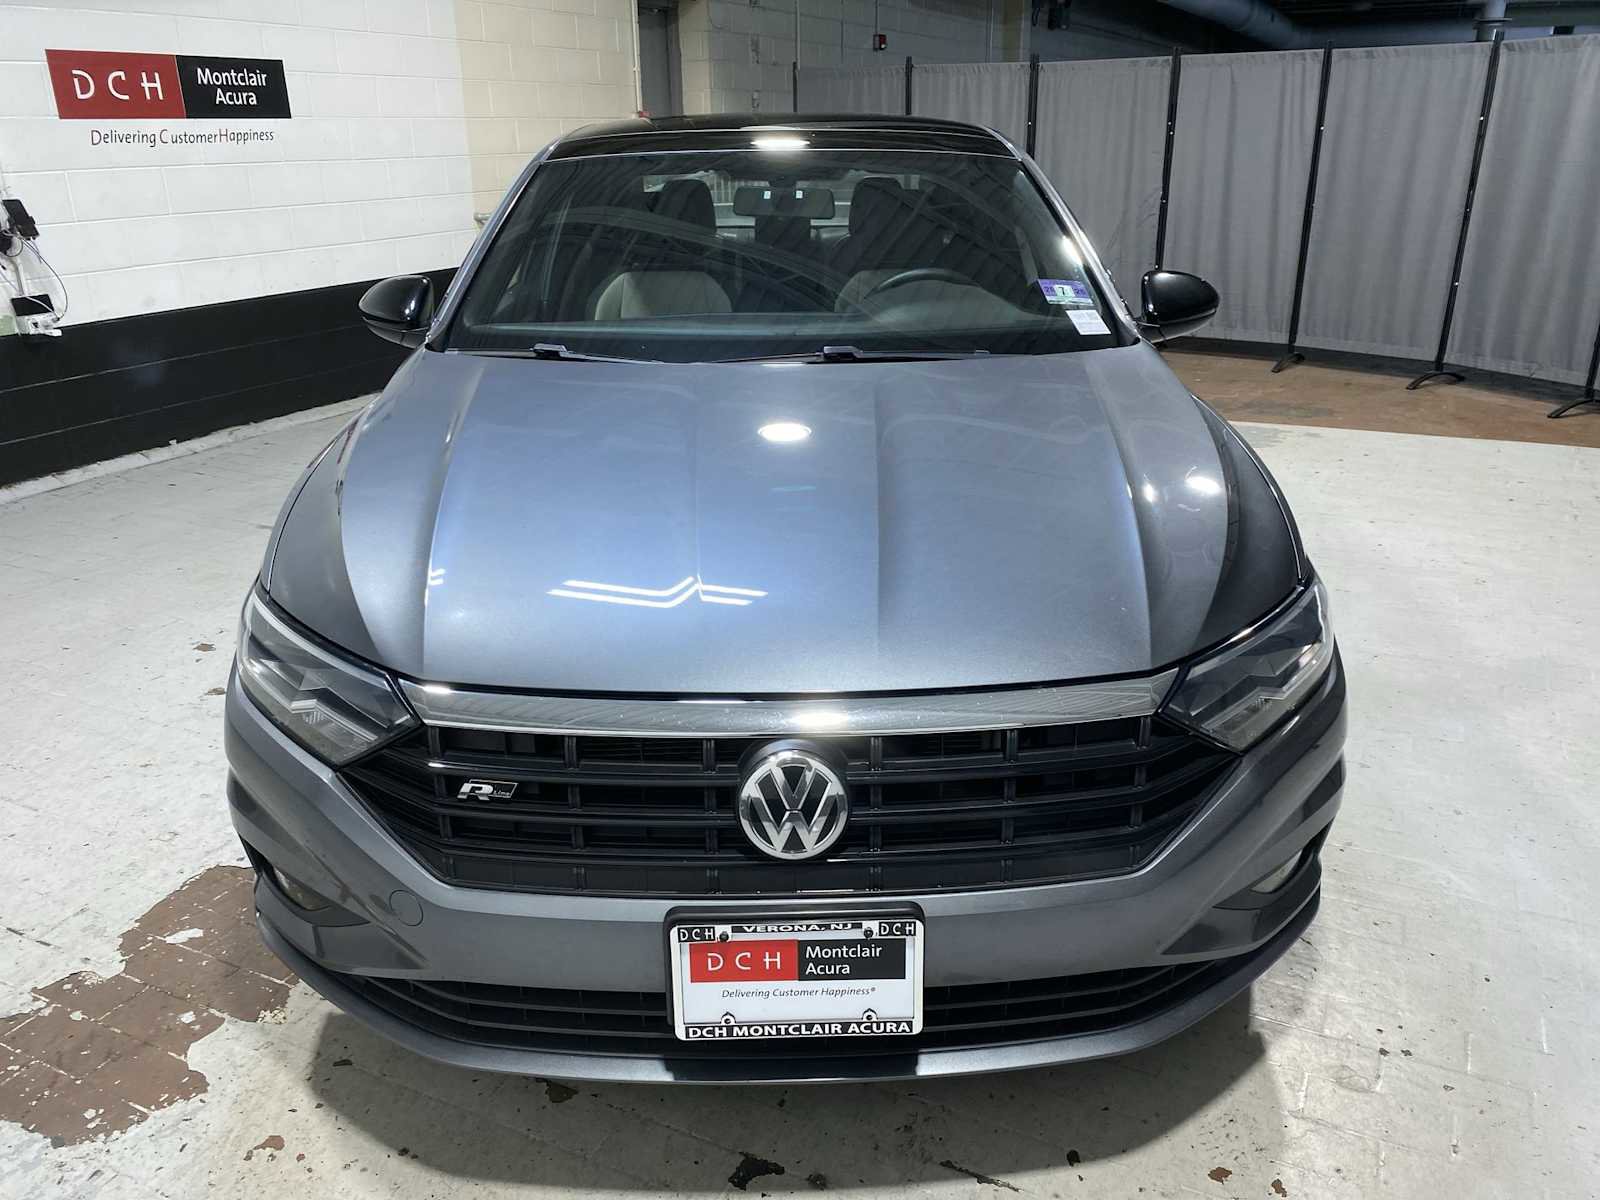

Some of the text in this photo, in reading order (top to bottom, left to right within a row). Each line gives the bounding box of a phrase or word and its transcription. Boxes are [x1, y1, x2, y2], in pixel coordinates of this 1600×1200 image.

[71, 69, 163, 100] DCH
[196, 67, 268, 87] Montclair
[215, 87, 257, 105] Acura
[90, 129, 156, 147] Delivering
[457, 782, 493, 800] R
[680, 928, 715, 941] DCH
[830, 922, 853, 930] NJ
[880, 922, 915, 935] DCH
[805, 944, 882, 959] Montclair
[707, 951, 781, 971] DCH
[805, 962, 850, 975] Acura
[722, 989, 770, 999] Delivering
[772, 988, 818, 997] Customer
[688, 1021, 911, 1038] DCH MONTCLAIR ACURA
